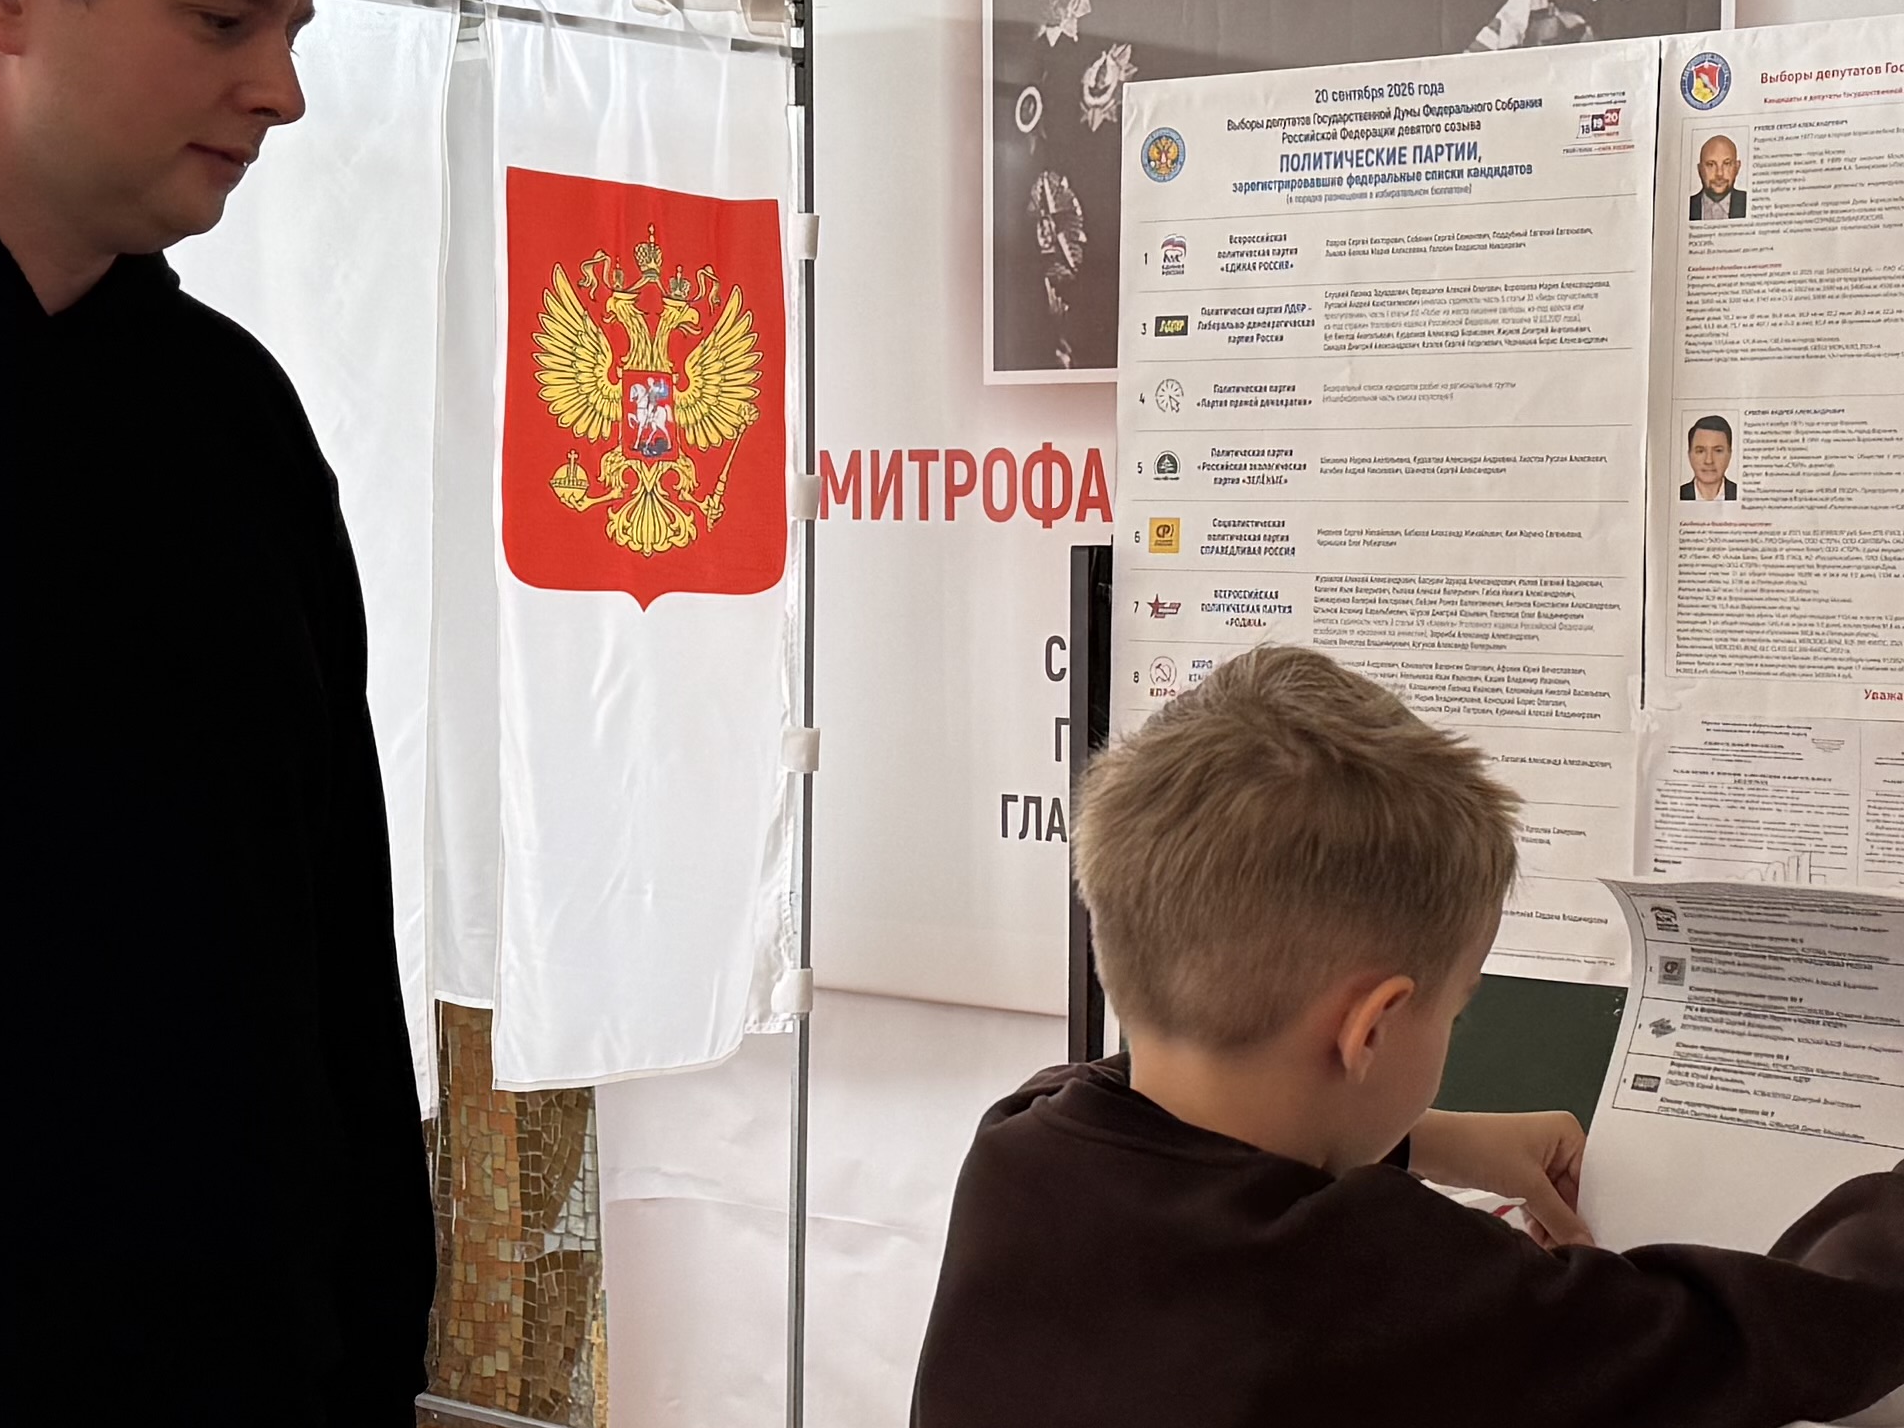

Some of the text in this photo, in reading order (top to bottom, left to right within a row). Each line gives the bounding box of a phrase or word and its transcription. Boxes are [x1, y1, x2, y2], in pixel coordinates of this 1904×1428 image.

[1760, 70, 1814, 85] Выборы
[1815, 64, 1882, 81] депутатов
[1314, 81, 1445, 104] 20 сентября 2026 года
[1279, 141, 1483, 173] ПОЛИТИЧЕСКИЕ ПАРТИИ,
[1140, 323, 1147, 336] 3
[1139, 392, 1145, 404] 4
[1137, 462, 1143, 474] 5
[819, 441, 1114, 529] МИТРОФА
[1134, 531, 1141, 544] 6
[1133, 601, 1139, 614] 7
[1044, 635, 1068, 683] С
[1133, 671, 1140, 684] 8
[1000, 794, 1068, 843] ГЛА
